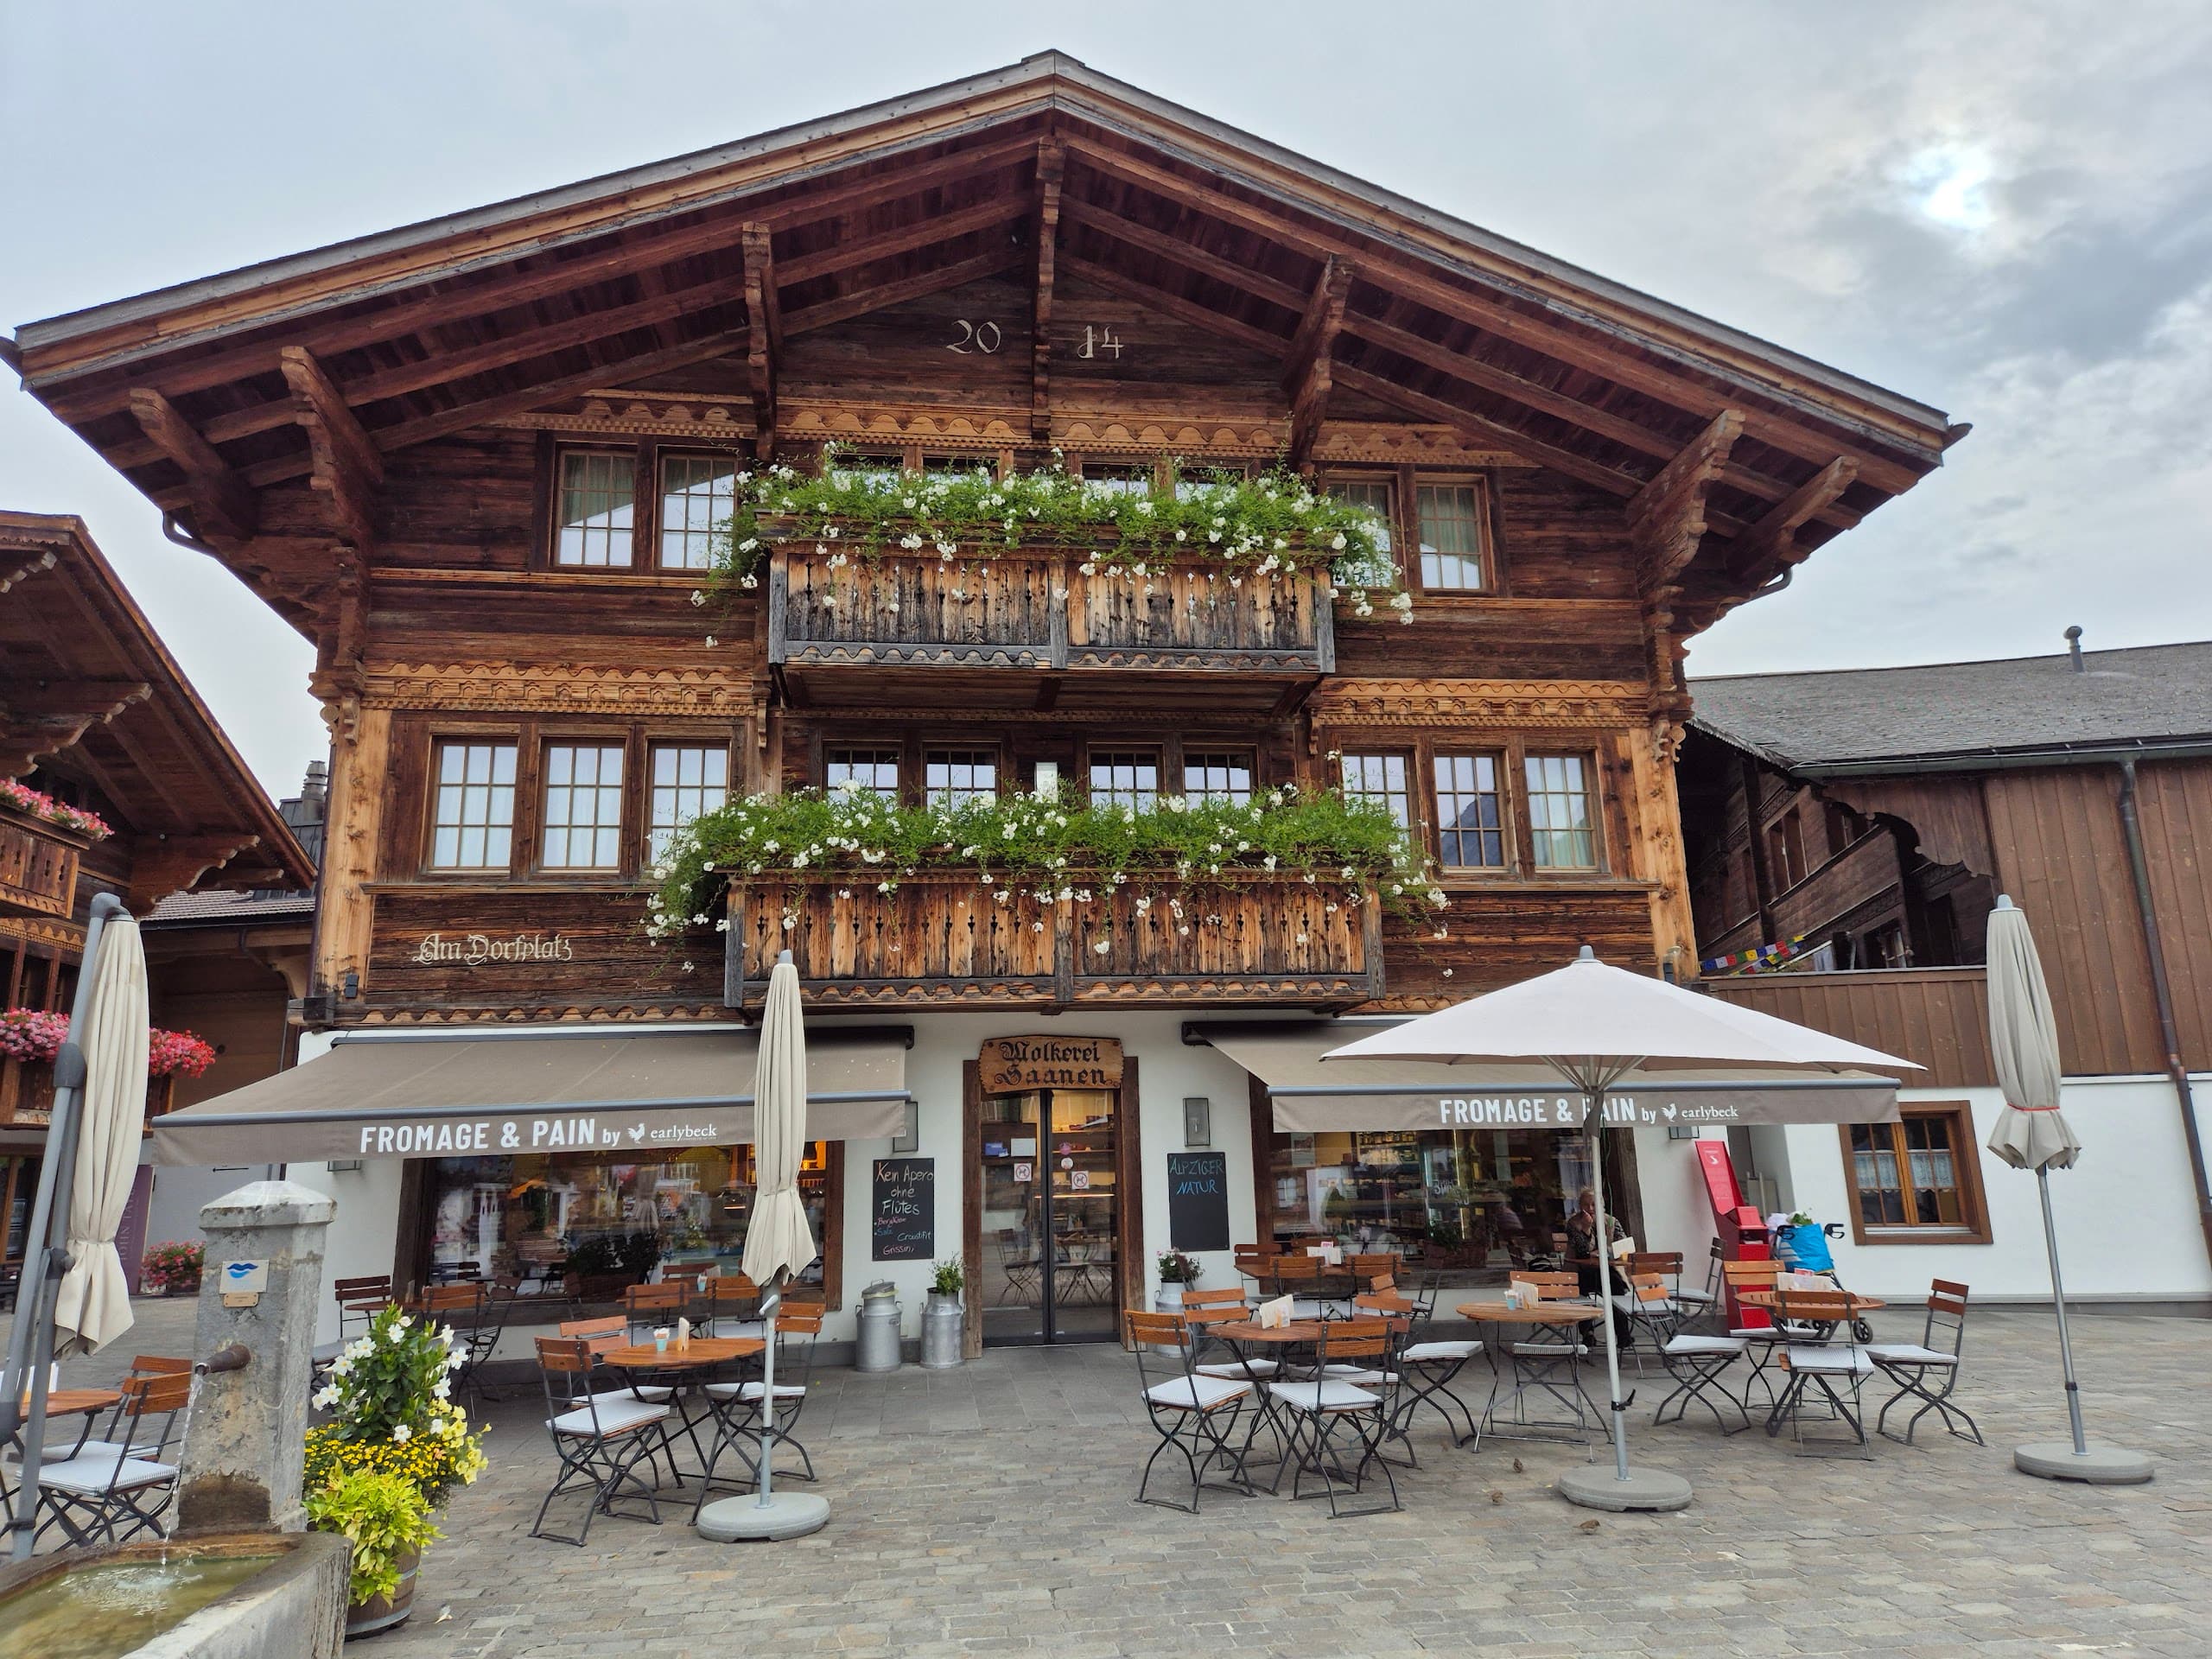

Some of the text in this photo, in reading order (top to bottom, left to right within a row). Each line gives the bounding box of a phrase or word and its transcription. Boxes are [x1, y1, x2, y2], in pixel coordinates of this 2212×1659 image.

[946, 320, 1123, 359] 20 14
[412, 933, 573, 965] Am Dorfplatz
[999, 1041, 1100, 1063] Molkerei
[995, 1064, 1107, 1085] Saanen
[1440, 1098, 1546, 1123] FROMAGE
[1556, 1098, 1573, 1122] &
[1641, 1107, 1656, 1124] by
[1681, 1105, 1739, 1121] earlybeck
[360, 1118, 717, 1153] FROMAGE & PAIN by earlybeck
[875, 1161, 899, 1183] Kein
[891, 1185, 916, 1198] ohne
[1176, 1179, 1218, 1196] NATUR
